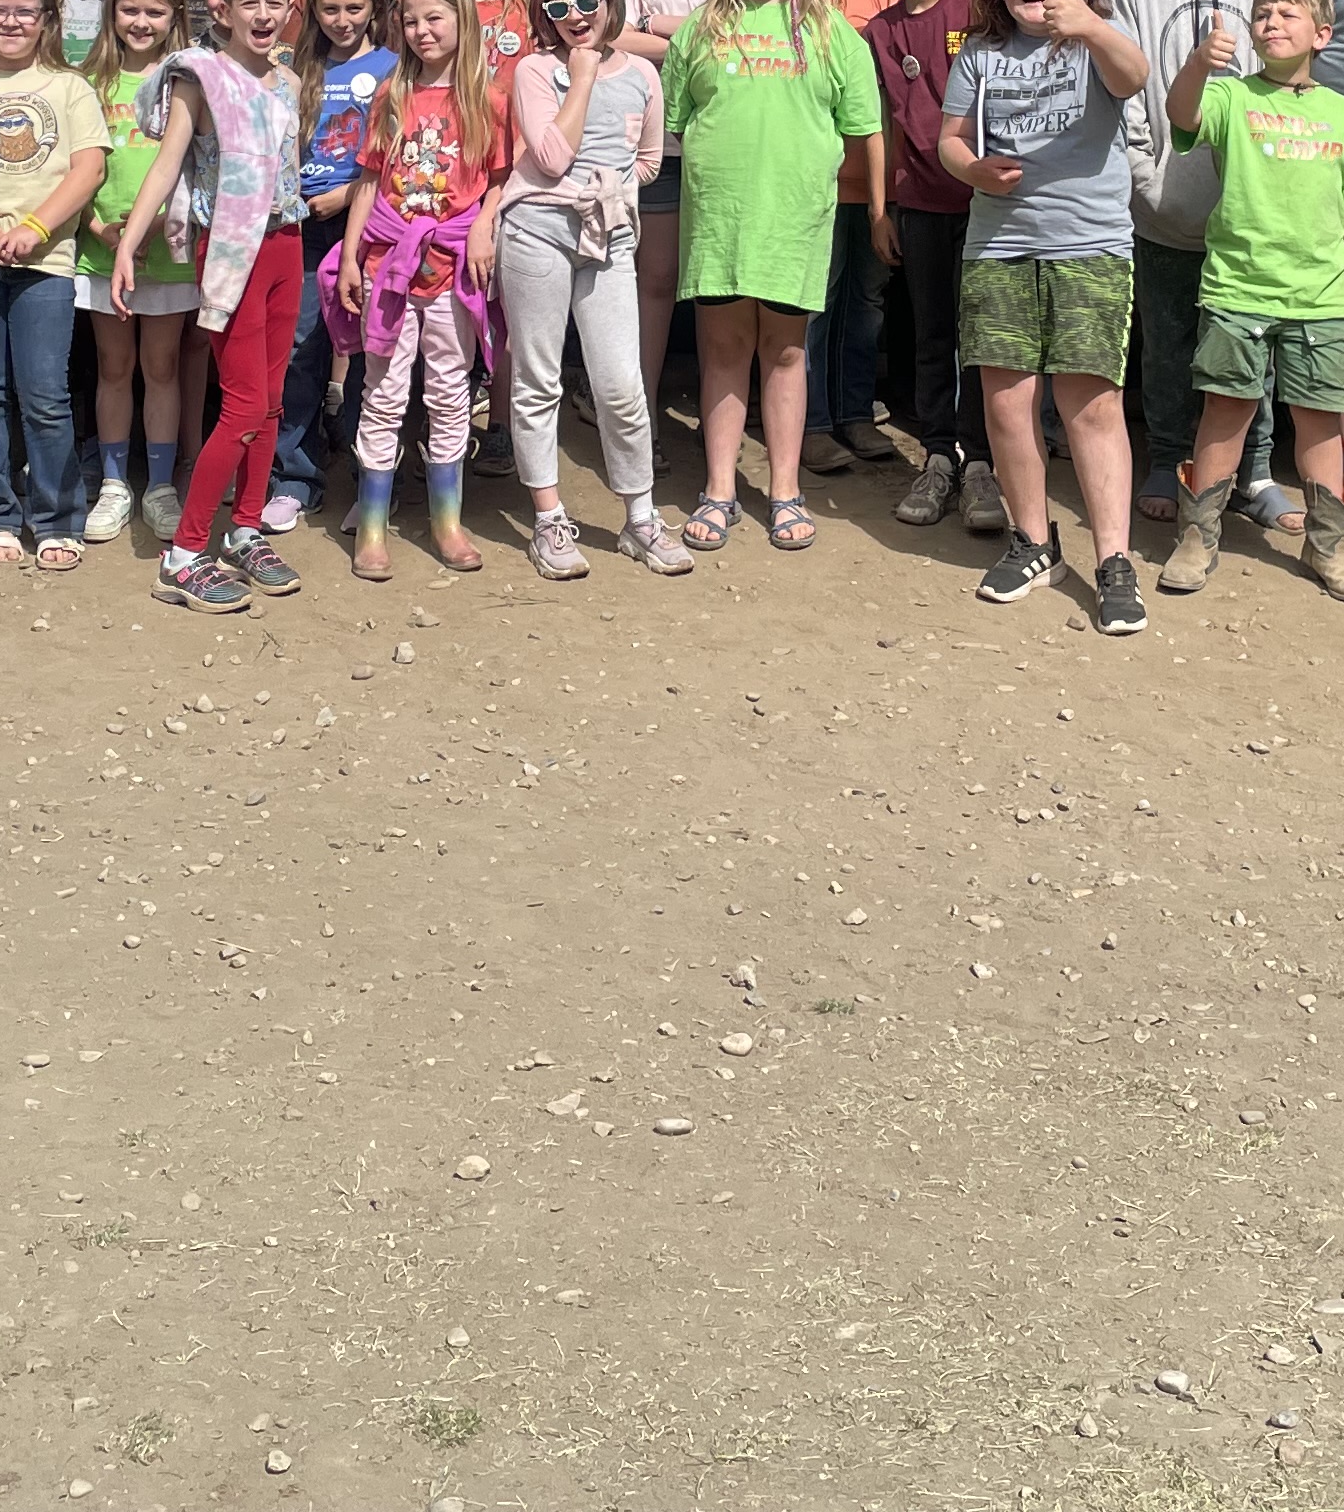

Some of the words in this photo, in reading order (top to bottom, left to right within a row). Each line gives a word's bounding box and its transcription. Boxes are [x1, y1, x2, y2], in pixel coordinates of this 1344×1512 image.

[324, 84, 351, 92] COUNT
[32, 97, 55, 129] WORRIES
[987, 111, 1071, 138] CAMPER
[1276, 138, 1344, 161] CAMP
